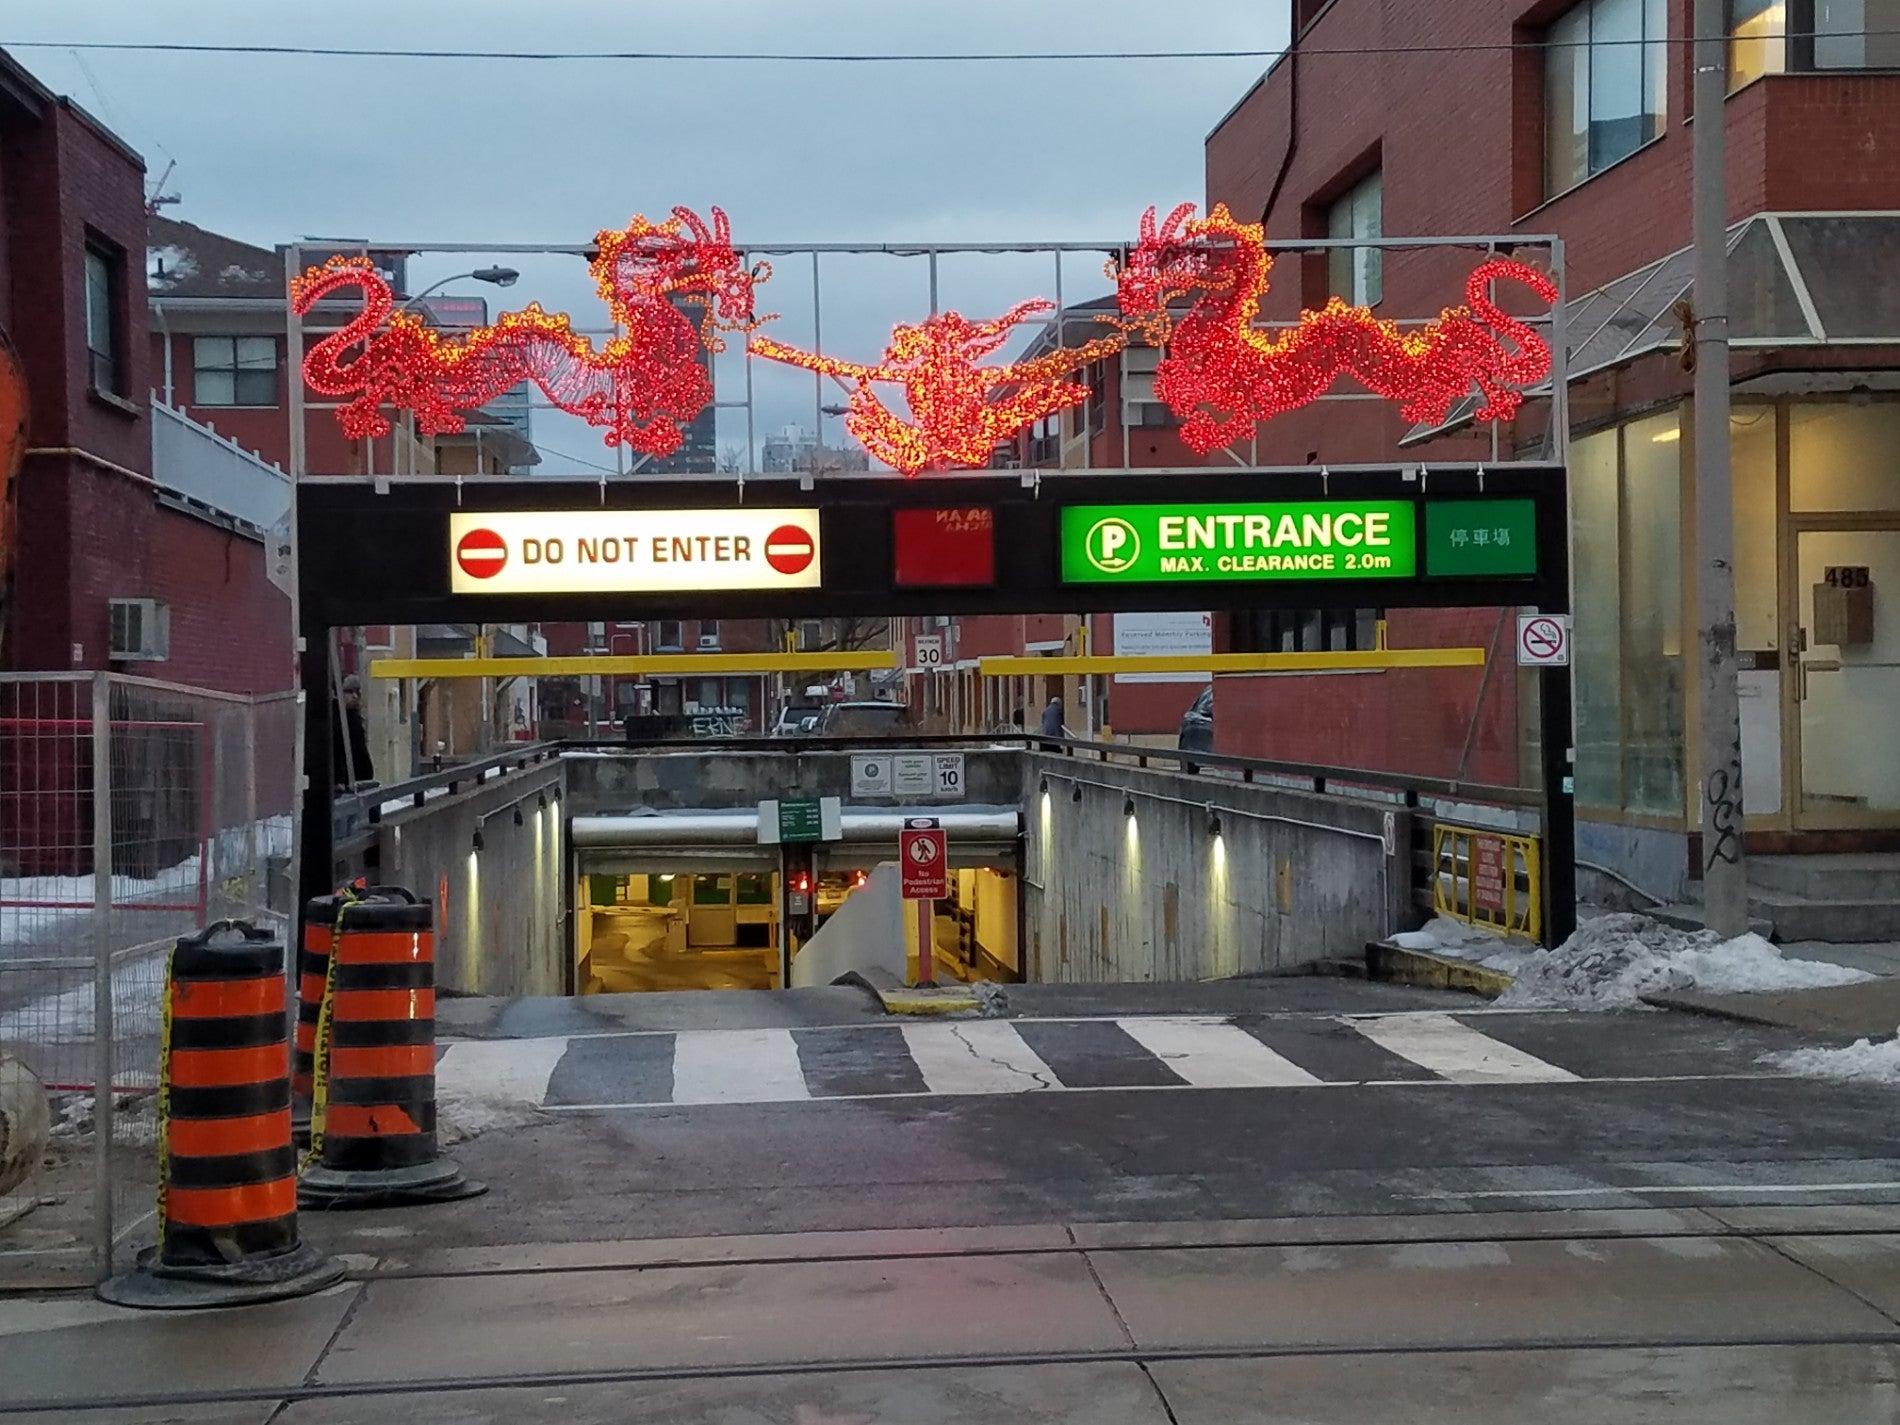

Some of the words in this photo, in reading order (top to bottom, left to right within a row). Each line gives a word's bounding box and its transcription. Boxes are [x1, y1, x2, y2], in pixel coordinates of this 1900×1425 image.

[1158, 512, 1390, 550] ENTRANCE
[1449, 527, 1511, 548] 停車場
[522, 538, 564, 564] DO
[577, 536, 639, 563] NOT
[652, 535, 751, 562] ENTER
[1101, 524, 1127, 559] P
[1160, 556, 1210, 573] MAX.
[1217, 554, 1335, 572] CLEARANCE
[1344, 553, 1391, 569] 2.0m
[919, 649, 939, 663] 30
[940, 770, 958, 786] 10
[903, 878, 945, 886] Pedestrian
[910, 886, 938, 894] Access
